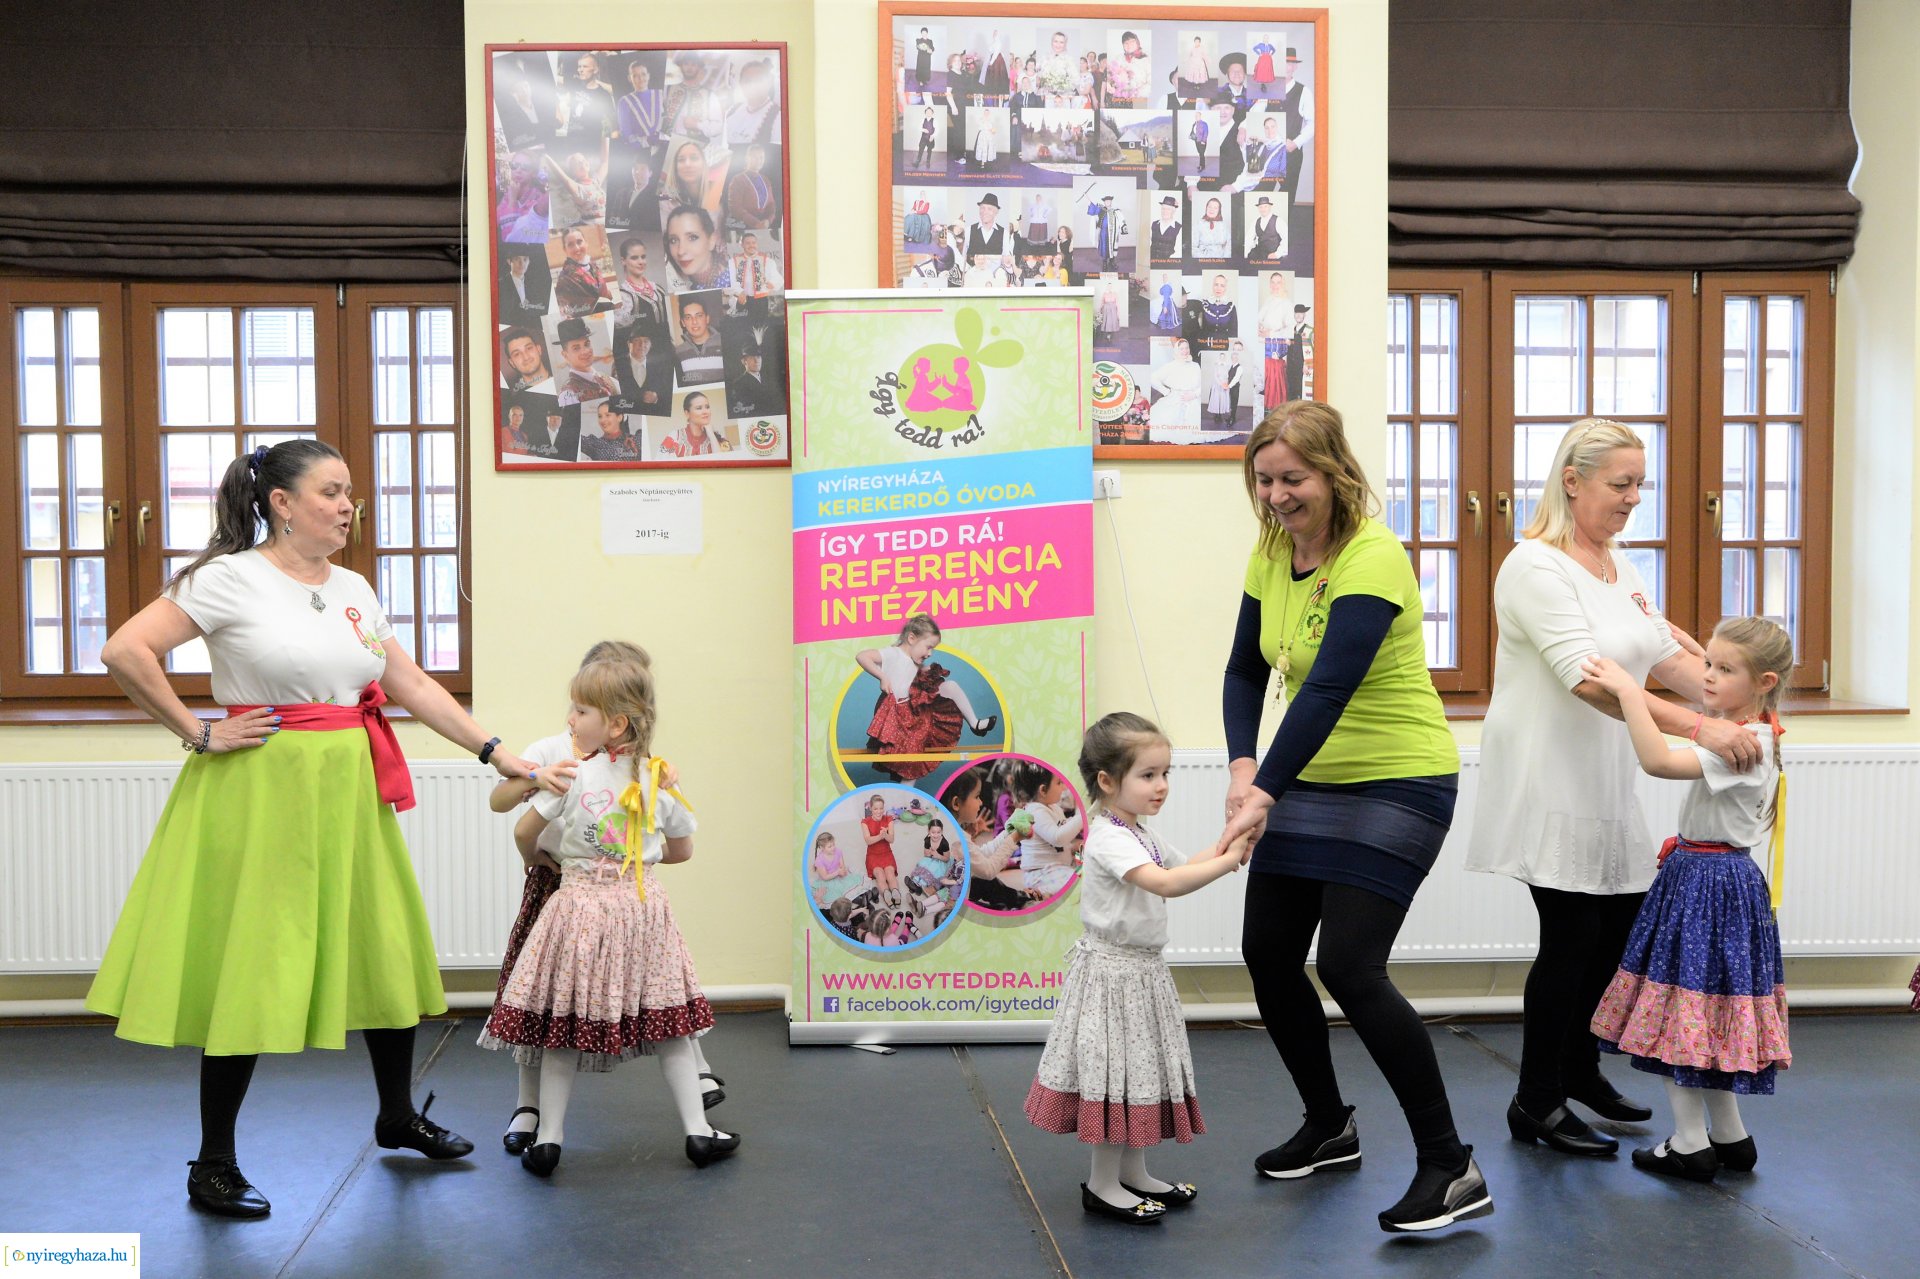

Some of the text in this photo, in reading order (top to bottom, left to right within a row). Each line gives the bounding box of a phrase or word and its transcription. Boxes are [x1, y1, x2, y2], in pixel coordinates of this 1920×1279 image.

[870, 372, 907, 418] Így
[894, 418, 944, 449] tedd
[640, 488, 693, 496] Néptáncegyüttes
[818, 470, 944, 494] NYÍREGYHÁZA
[818, 482, 1036, 517] KEREKERDŐ ÓVODA
[636, 530, 670, 539] 2017-ig
[819, 517, 1004, 558] ÍGY TEDD RÁ!
[820, 542, 1062, 591] REFERENCIA
[820, 578, 1038, 627] INTÉZMÉNY
